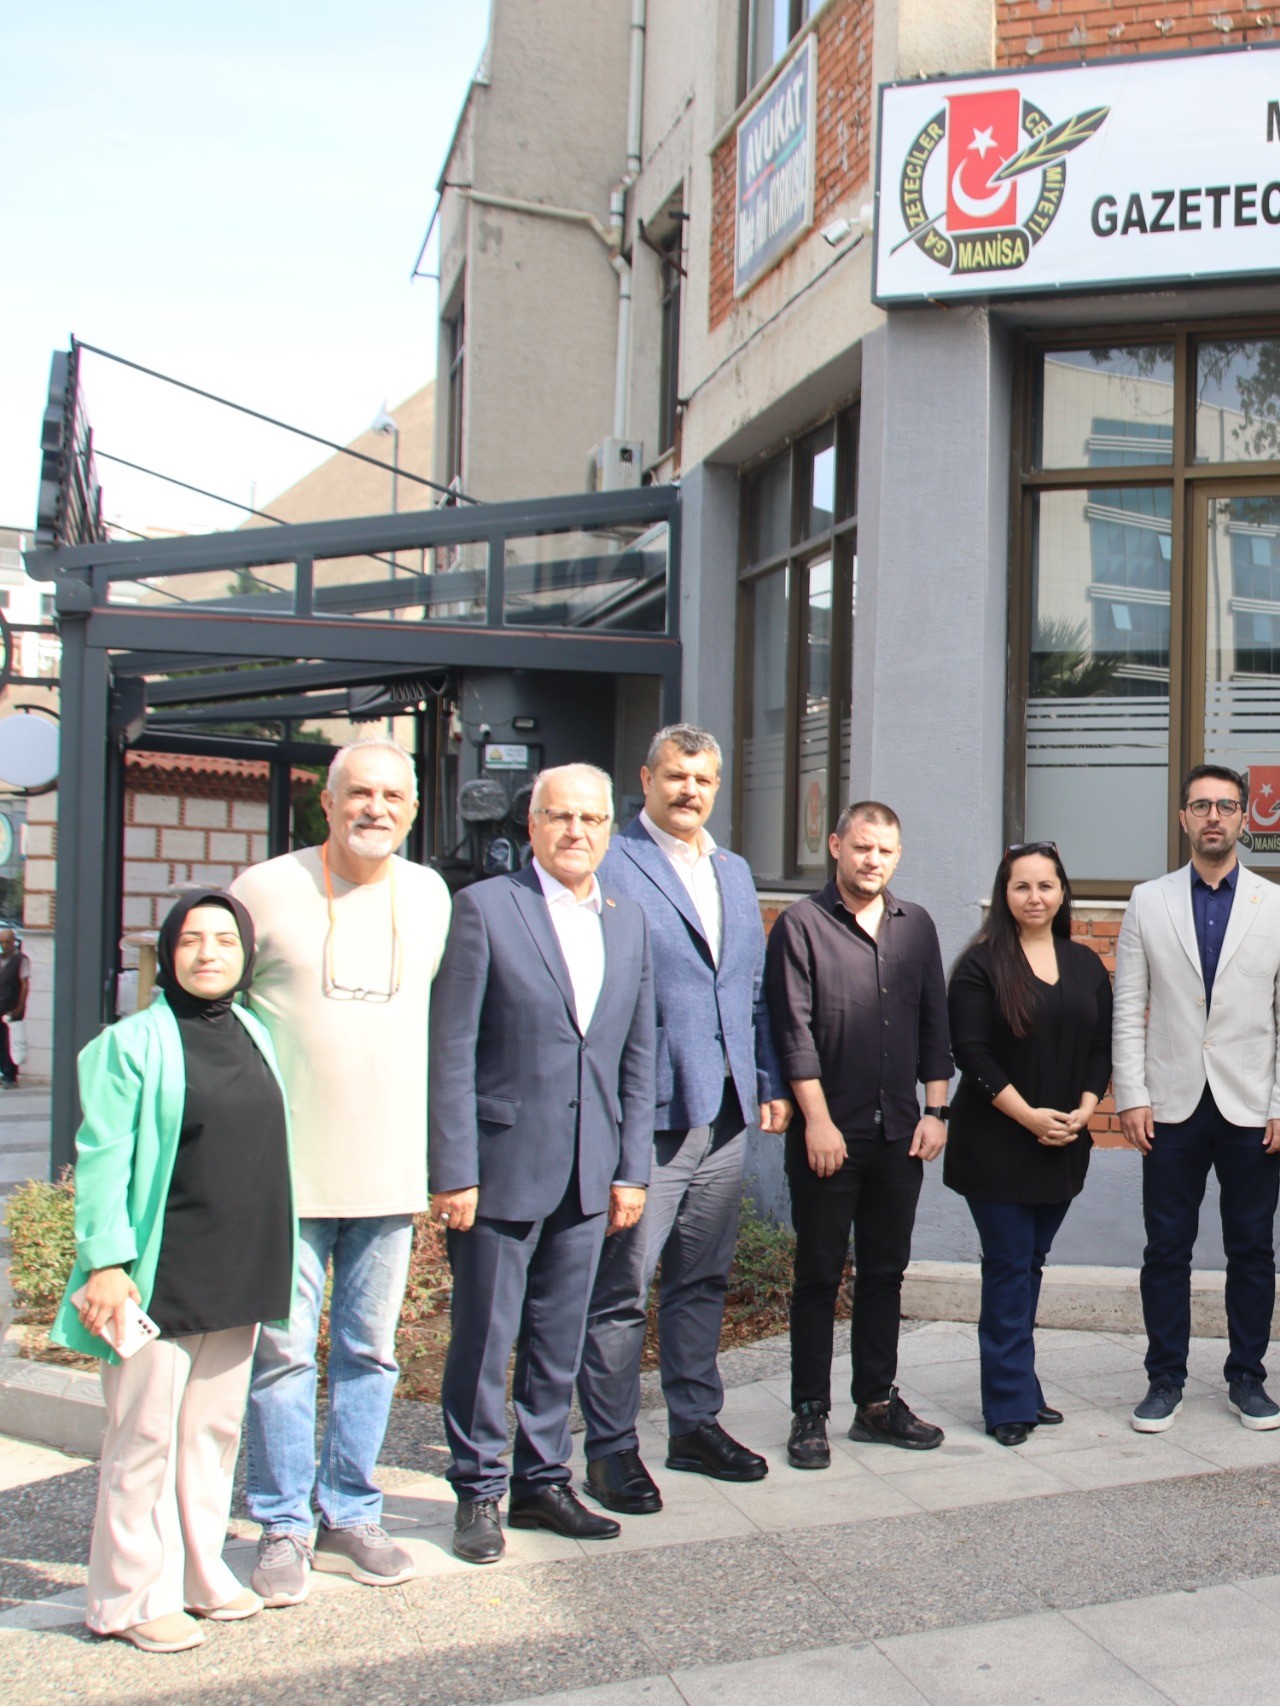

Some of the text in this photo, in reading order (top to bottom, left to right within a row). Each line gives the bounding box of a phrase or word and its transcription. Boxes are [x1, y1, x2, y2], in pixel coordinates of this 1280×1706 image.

[746, 71, 804, 183] AVUKAT
[903, 122, 947, 259] GAZETECİLER
[958, 234, 1025, 269] MANİSA
